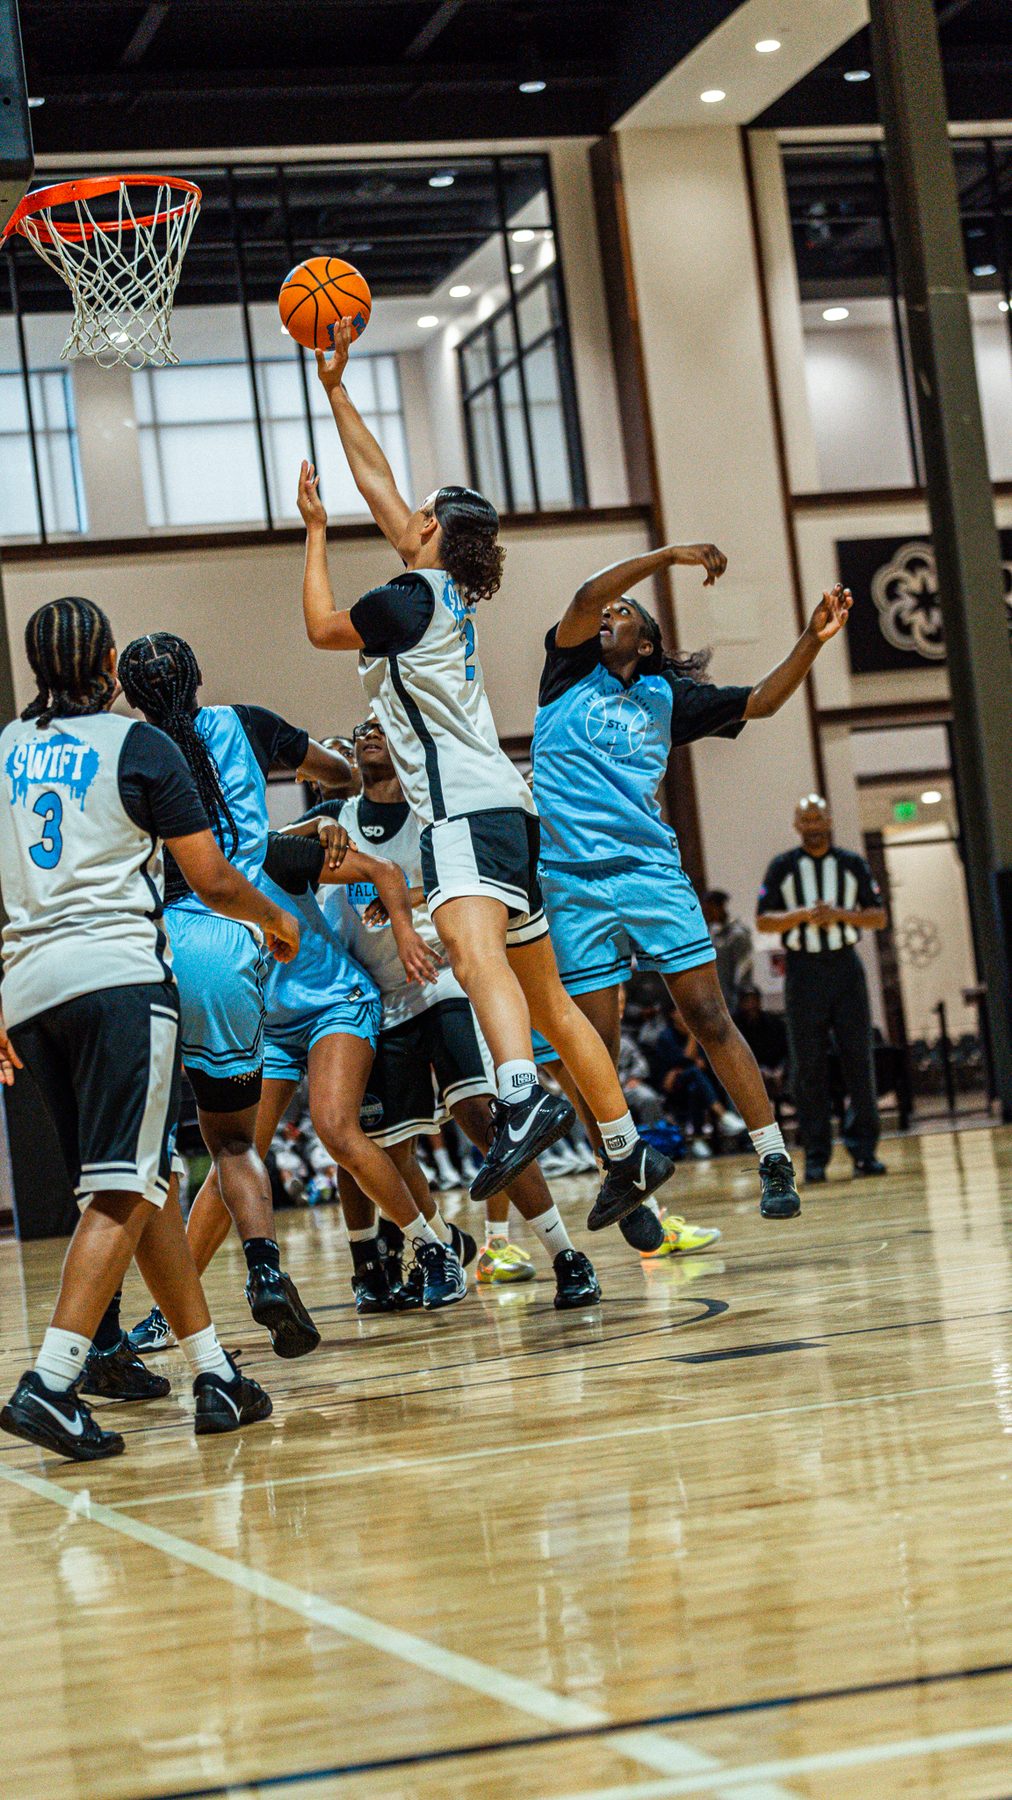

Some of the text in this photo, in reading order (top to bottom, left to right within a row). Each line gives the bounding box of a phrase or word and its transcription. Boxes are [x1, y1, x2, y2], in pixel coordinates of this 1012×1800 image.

[13, 743, 91, 781] SWIFT
[28, 791, 63, 870] 3
[348, 883, 380, 897] FALC
